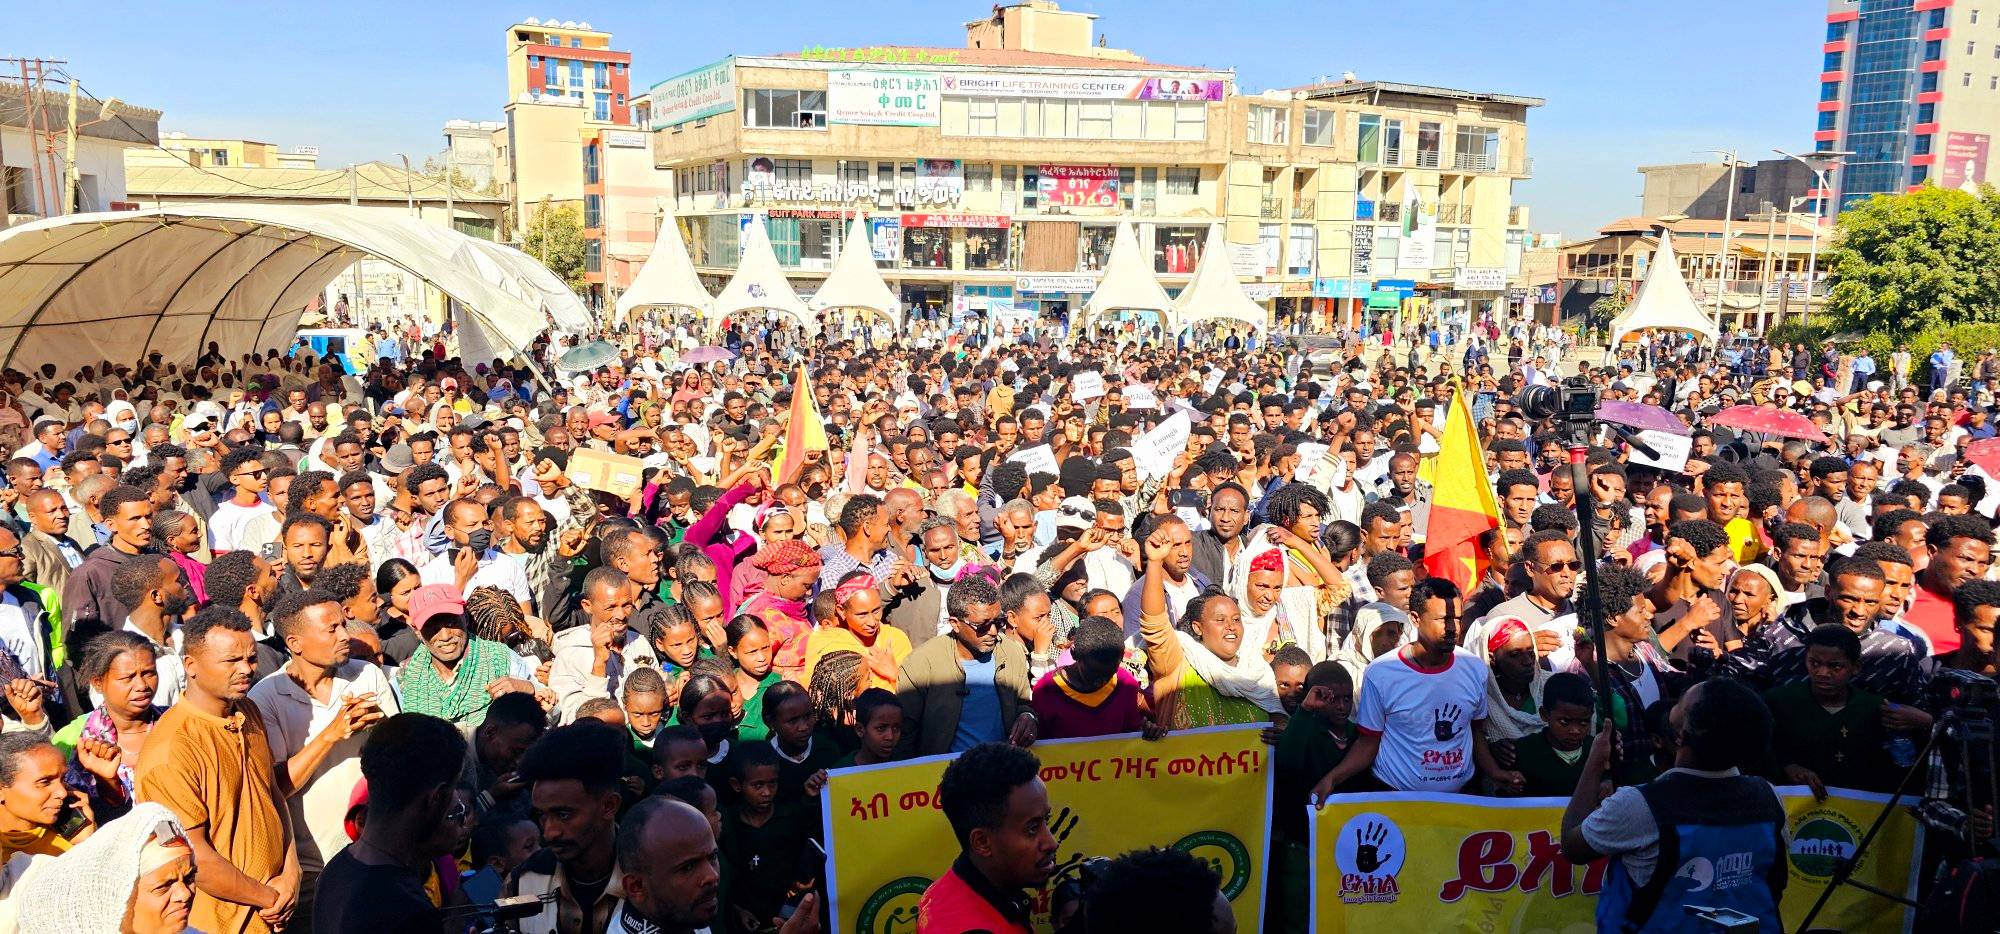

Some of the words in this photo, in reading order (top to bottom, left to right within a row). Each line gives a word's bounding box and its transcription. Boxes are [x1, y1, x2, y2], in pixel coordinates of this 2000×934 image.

[959, 79, 1000, 88] BRIGHT
[1002, 81, 1026, 89] LIFE
[1028, 81, 1080, 90] TRAINING
[1081, 83, 1125, 91] CENTER
[878, 92, 926, 110] ቀመር
[769, 210, 789, 218] SUIT
[791, 210, 816, 219] PARK
[1152, 428, 1178, 447] Enough
[1039, 758, 1102, 783] መሃር
[1110, 757, 1160, 779] ገዛና
[850, 792, 889, 821] ኣብ
[623, 912, 643, 932] LOUIS
